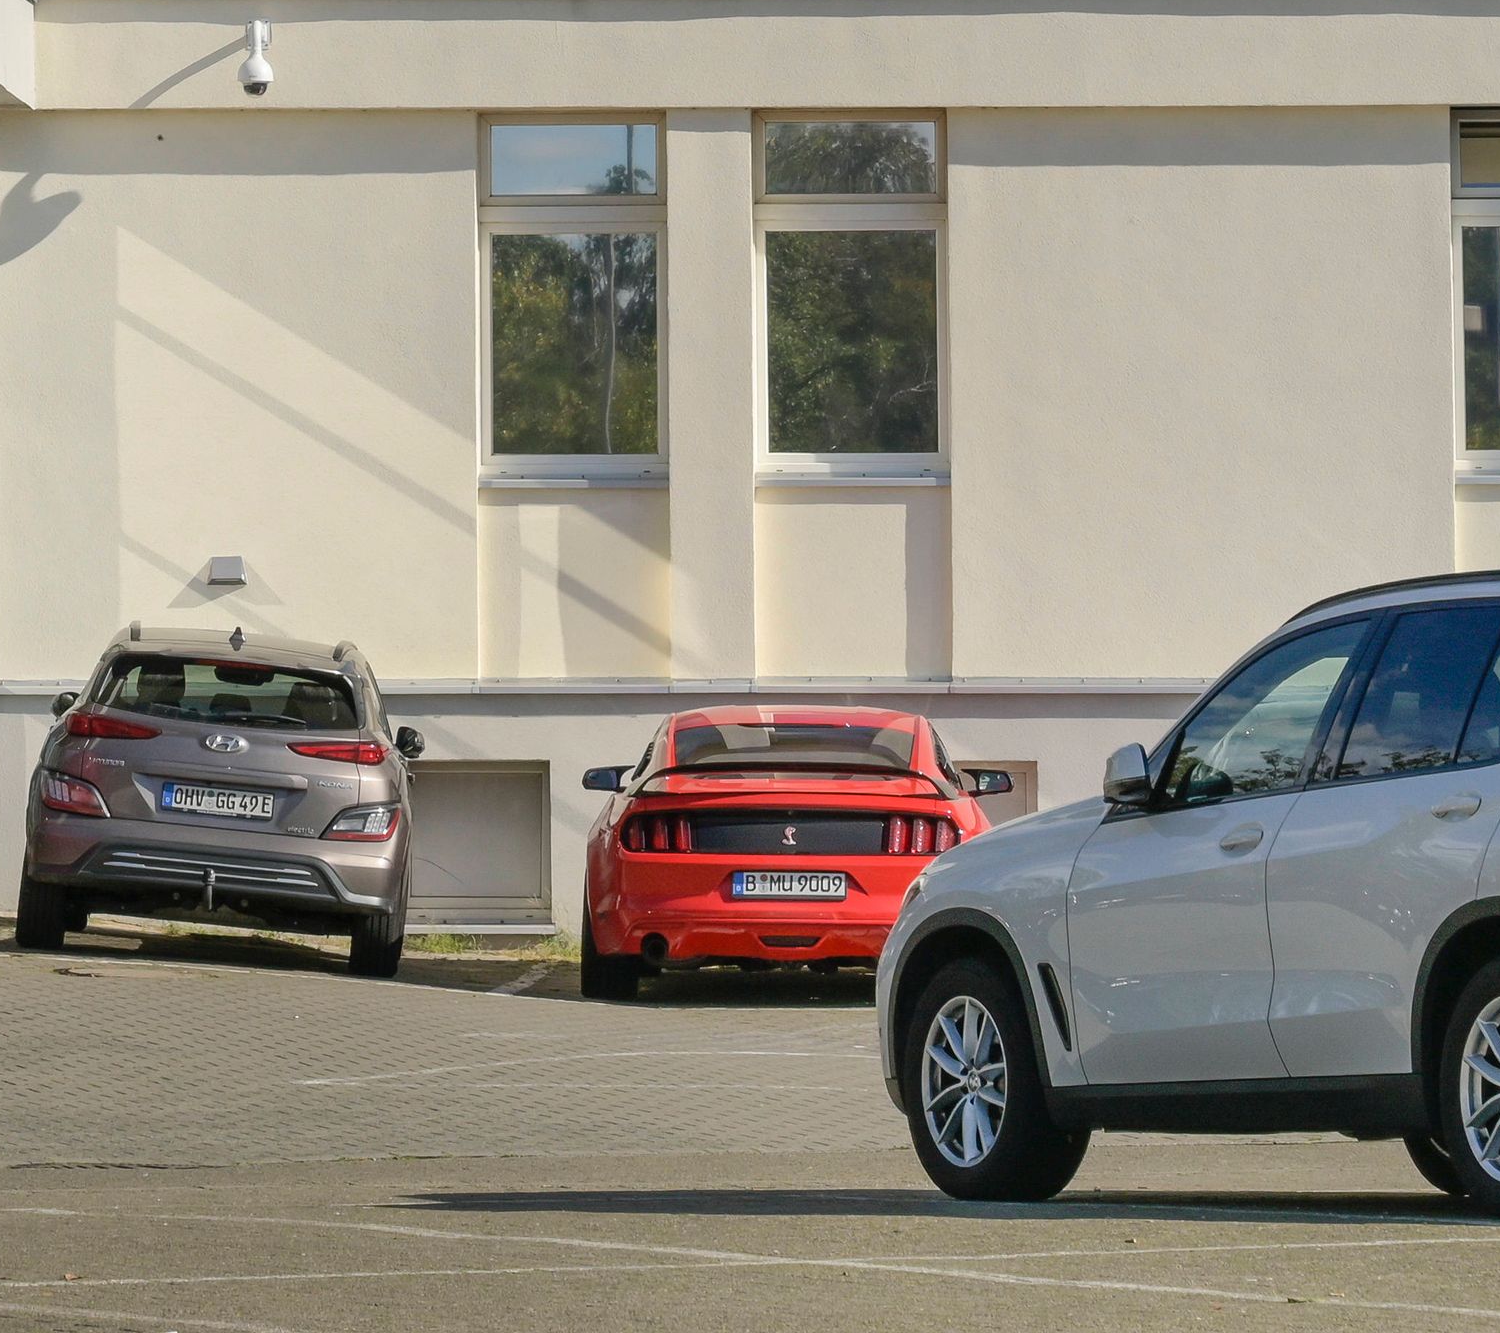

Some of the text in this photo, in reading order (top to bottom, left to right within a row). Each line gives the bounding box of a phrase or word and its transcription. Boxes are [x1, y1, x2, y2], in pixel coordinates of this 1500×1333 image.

[174, 788, 205, 806] OHV
[216, 792, 236, 810] GG
[240, 794, 259, 812] 49
[745, 875, 756, 891] B
[769, 875, 793, 892] MU
[798, 875, 842, 893] 9009
